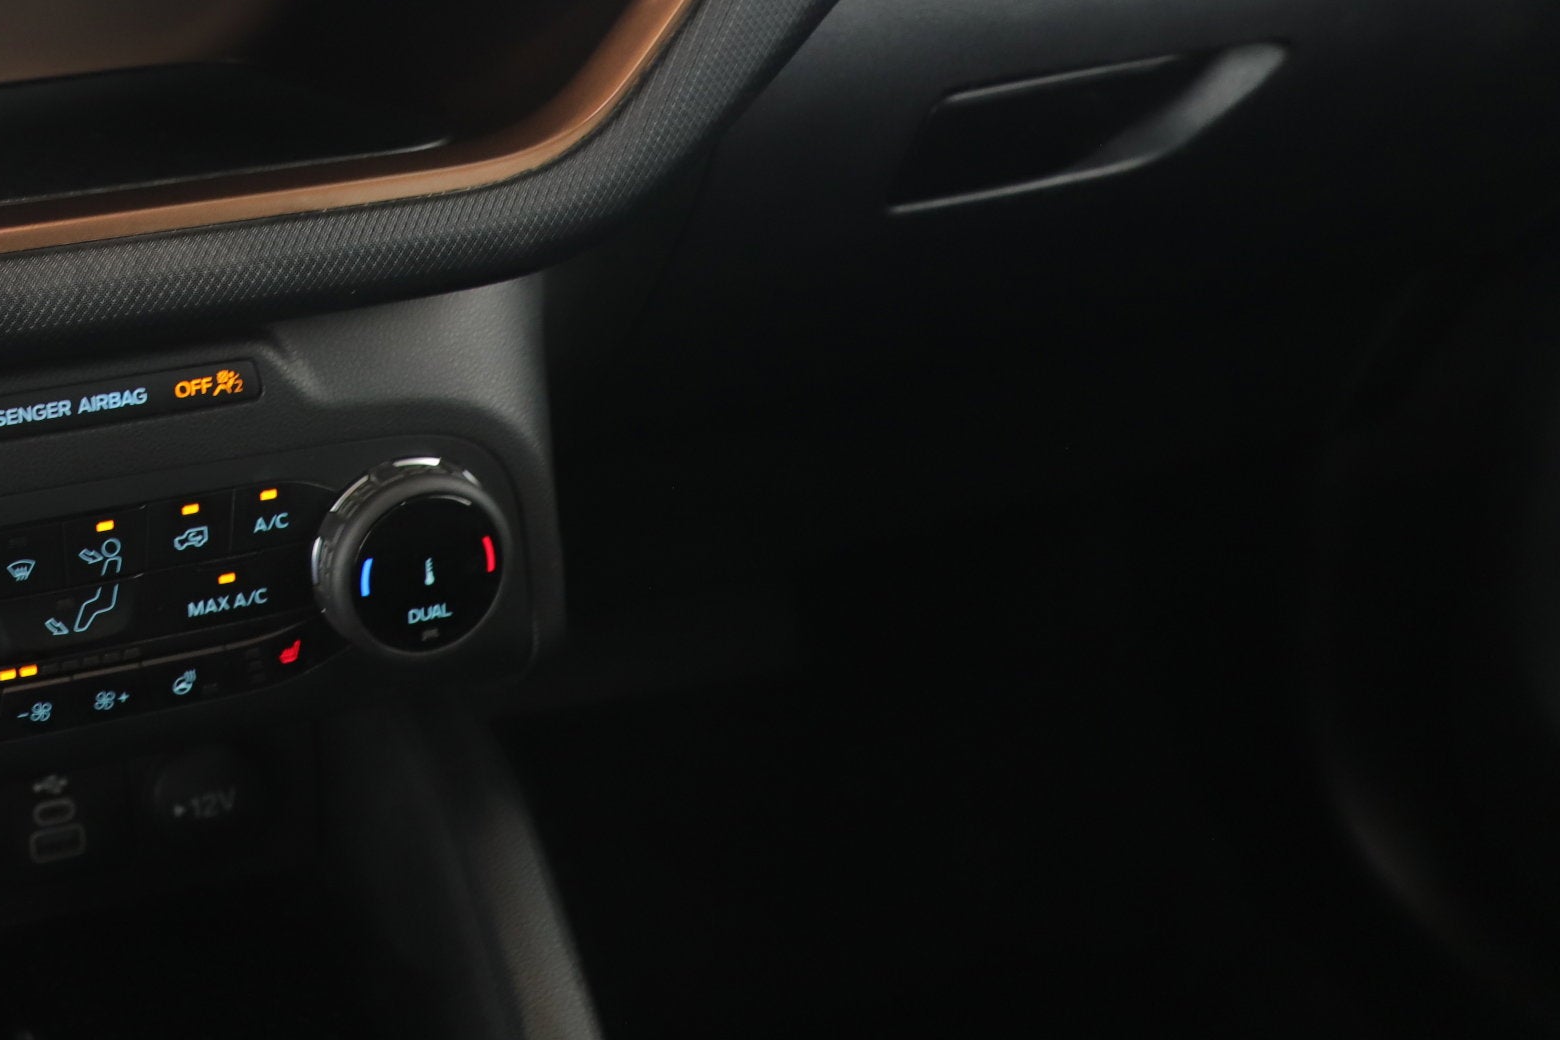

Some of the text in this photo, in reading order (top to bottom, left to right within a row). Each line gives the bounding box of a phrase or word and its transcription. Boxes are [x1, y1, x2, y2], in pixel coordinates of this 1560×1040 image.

[77, 387, 148, 415] AIRBAG
[174, 376, 213, 400] OFF
[253, 511, 290, 534] A/C
[187, 587, 269, 618] MAX A/C
[407, 600, 454, 625] DUAL
[190, 788, 237, 820] 12V
